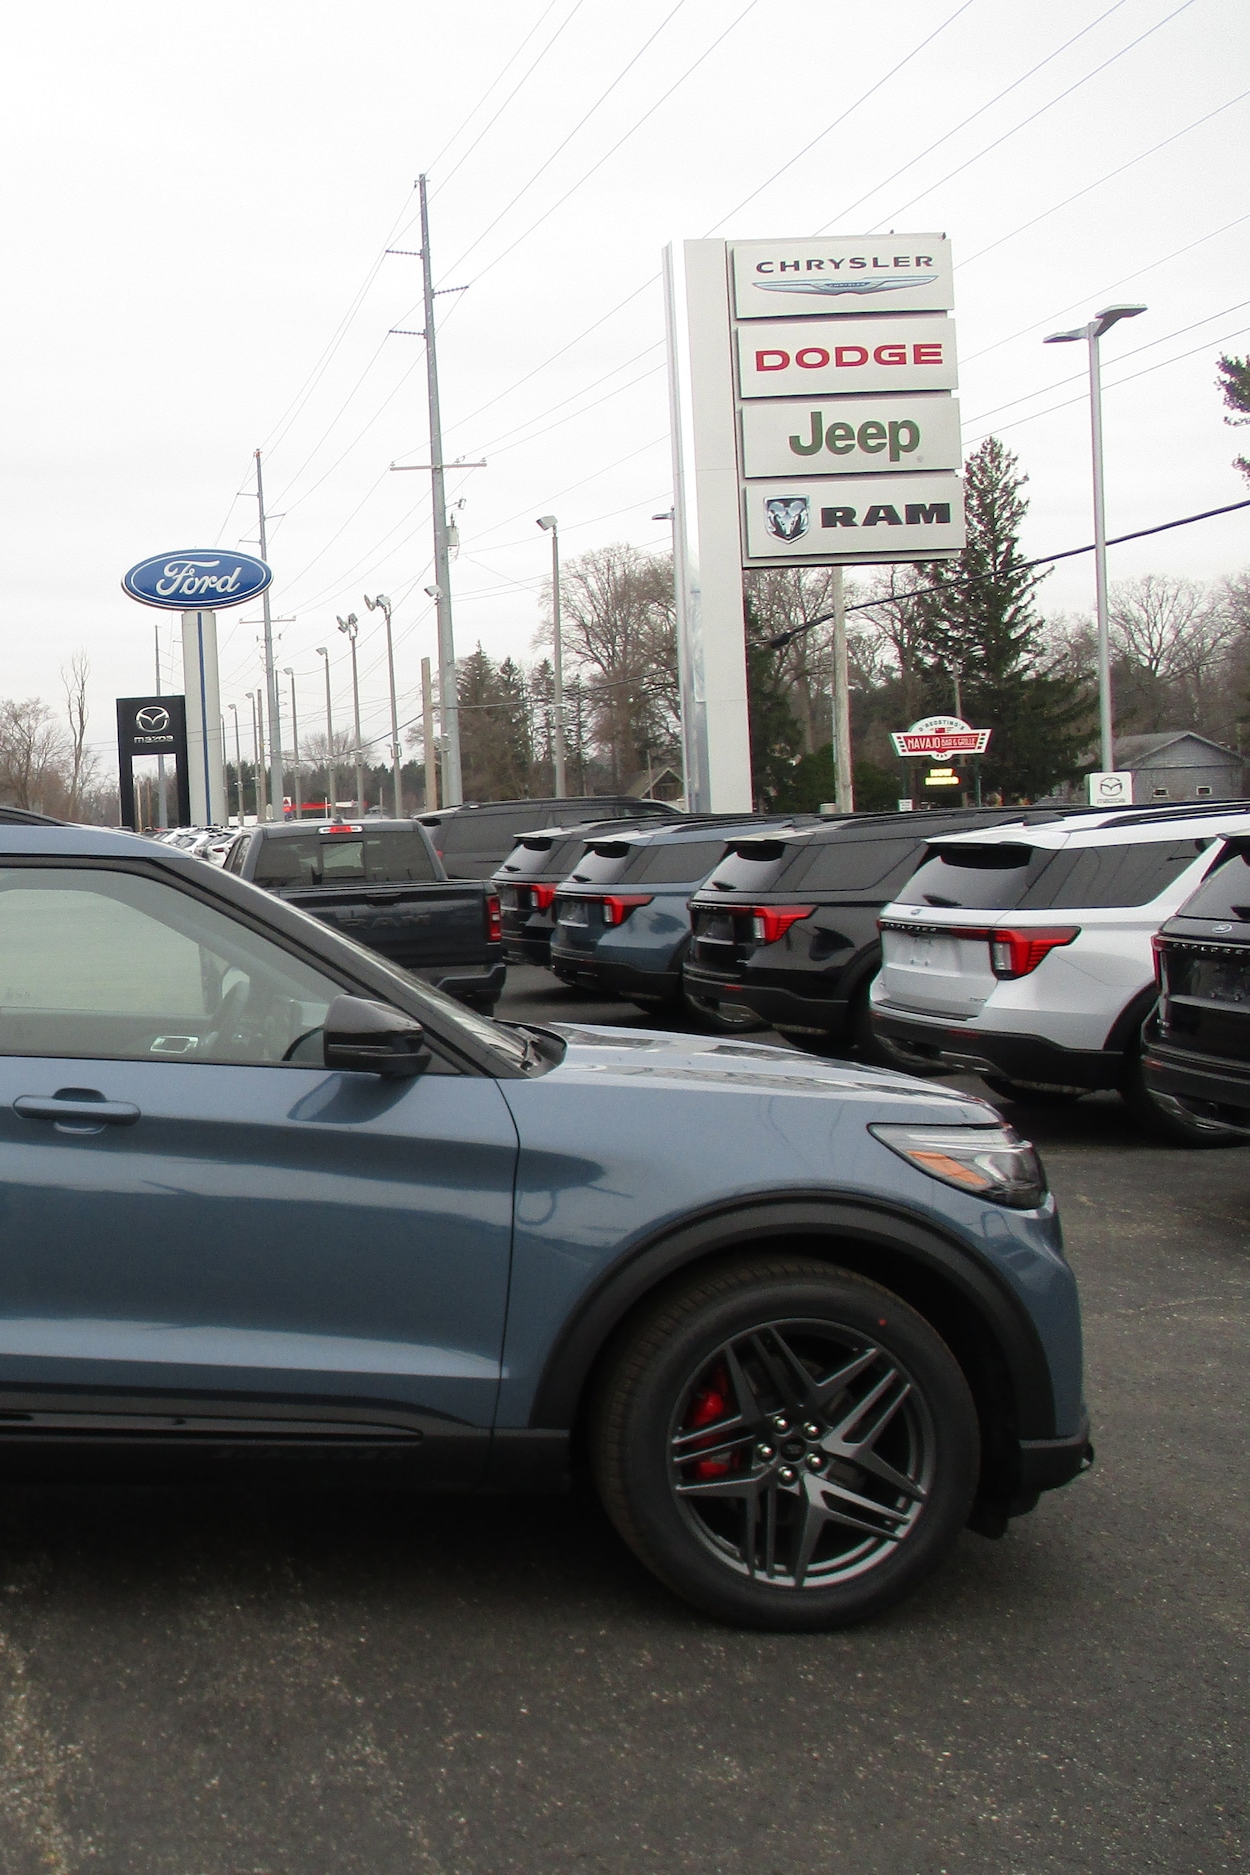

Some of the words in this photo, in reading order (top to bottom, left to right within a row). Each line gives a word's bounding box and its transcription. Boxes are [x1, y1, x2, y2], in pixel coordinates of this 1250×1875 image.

[755, 255, 934, 274] CHRYSLER
[754, 343, 944, 372] DODGE
[788, 411, 921, 462] Jeep
[820, 502, 951, 529] RAM
[155, 559, 243, 596] Ford
[133, 734, 174, 744] mazda
[907, 737, 941, 750] NAVAJO
[1172, 942, 1250, 955] EXPLORE
